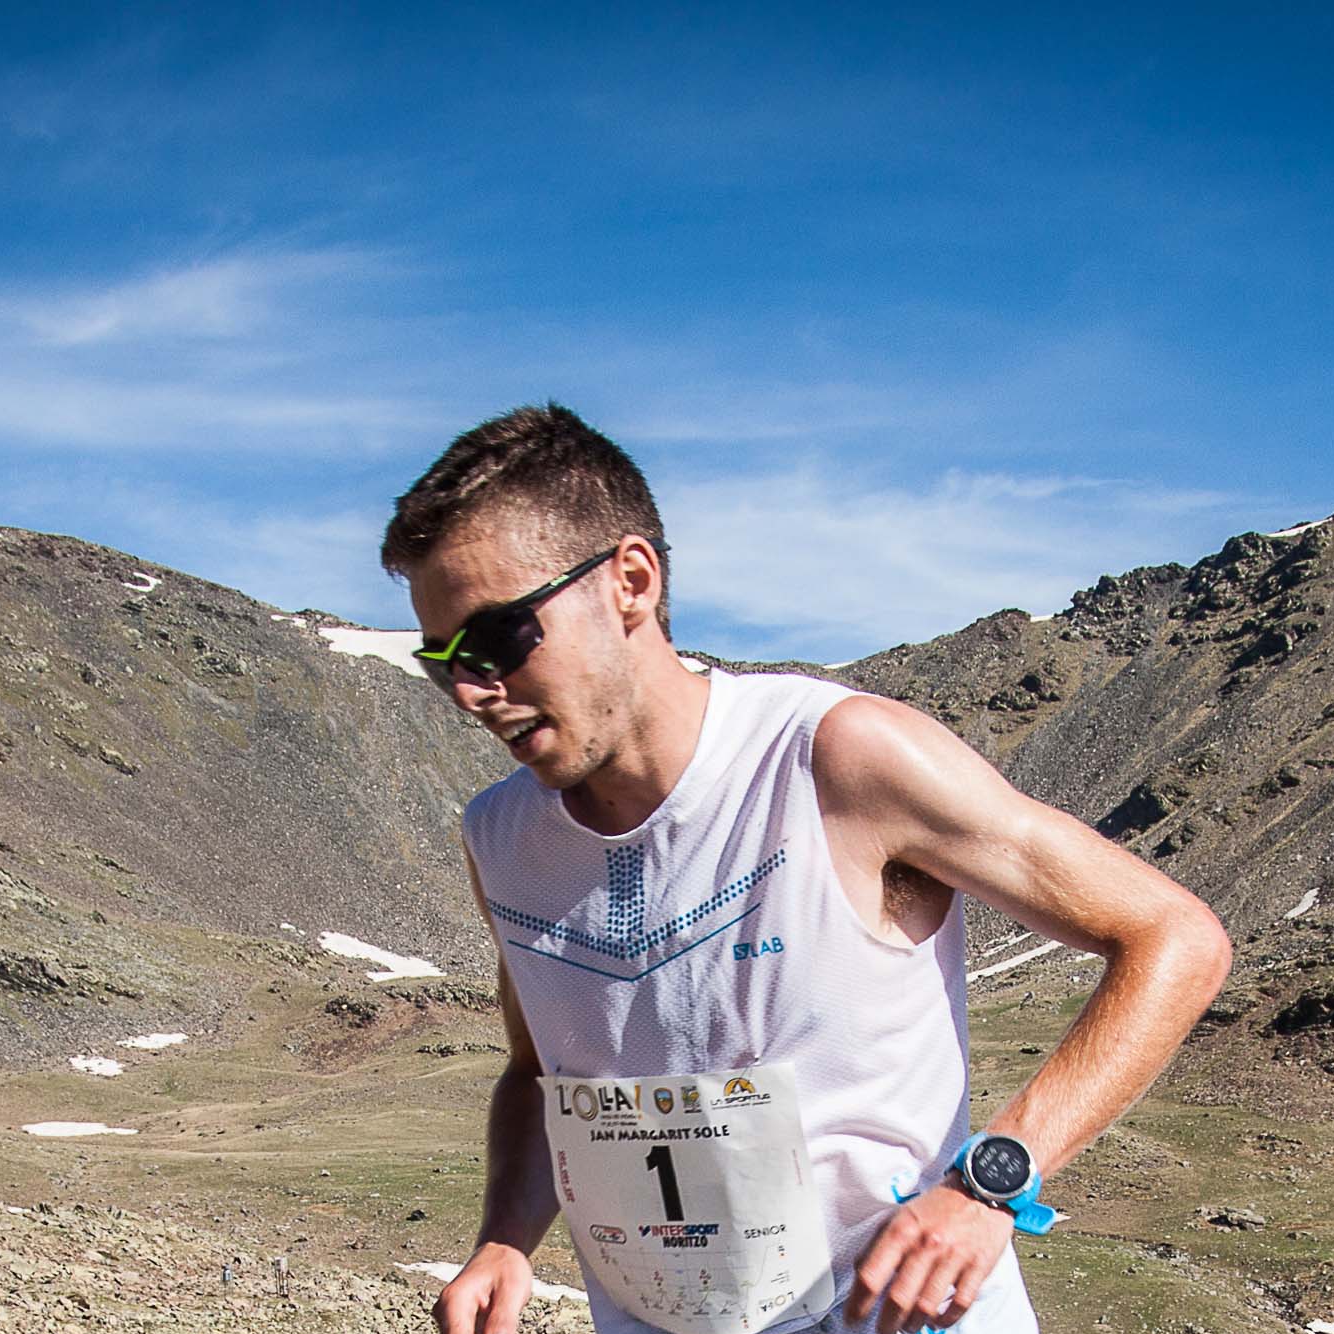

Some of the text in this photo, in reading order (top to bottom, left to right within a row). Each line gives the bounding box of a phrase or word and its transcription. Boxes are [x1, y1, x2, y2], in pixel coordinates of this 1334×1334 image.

[591, 1125, 730, 1142] JAN MARGARIT SOLE
[645, 1145, 685, 1222] 1
[651, 1224, 719, 1237] INTERSPORT
[744, 1224, 786, 1239] SENIOR
